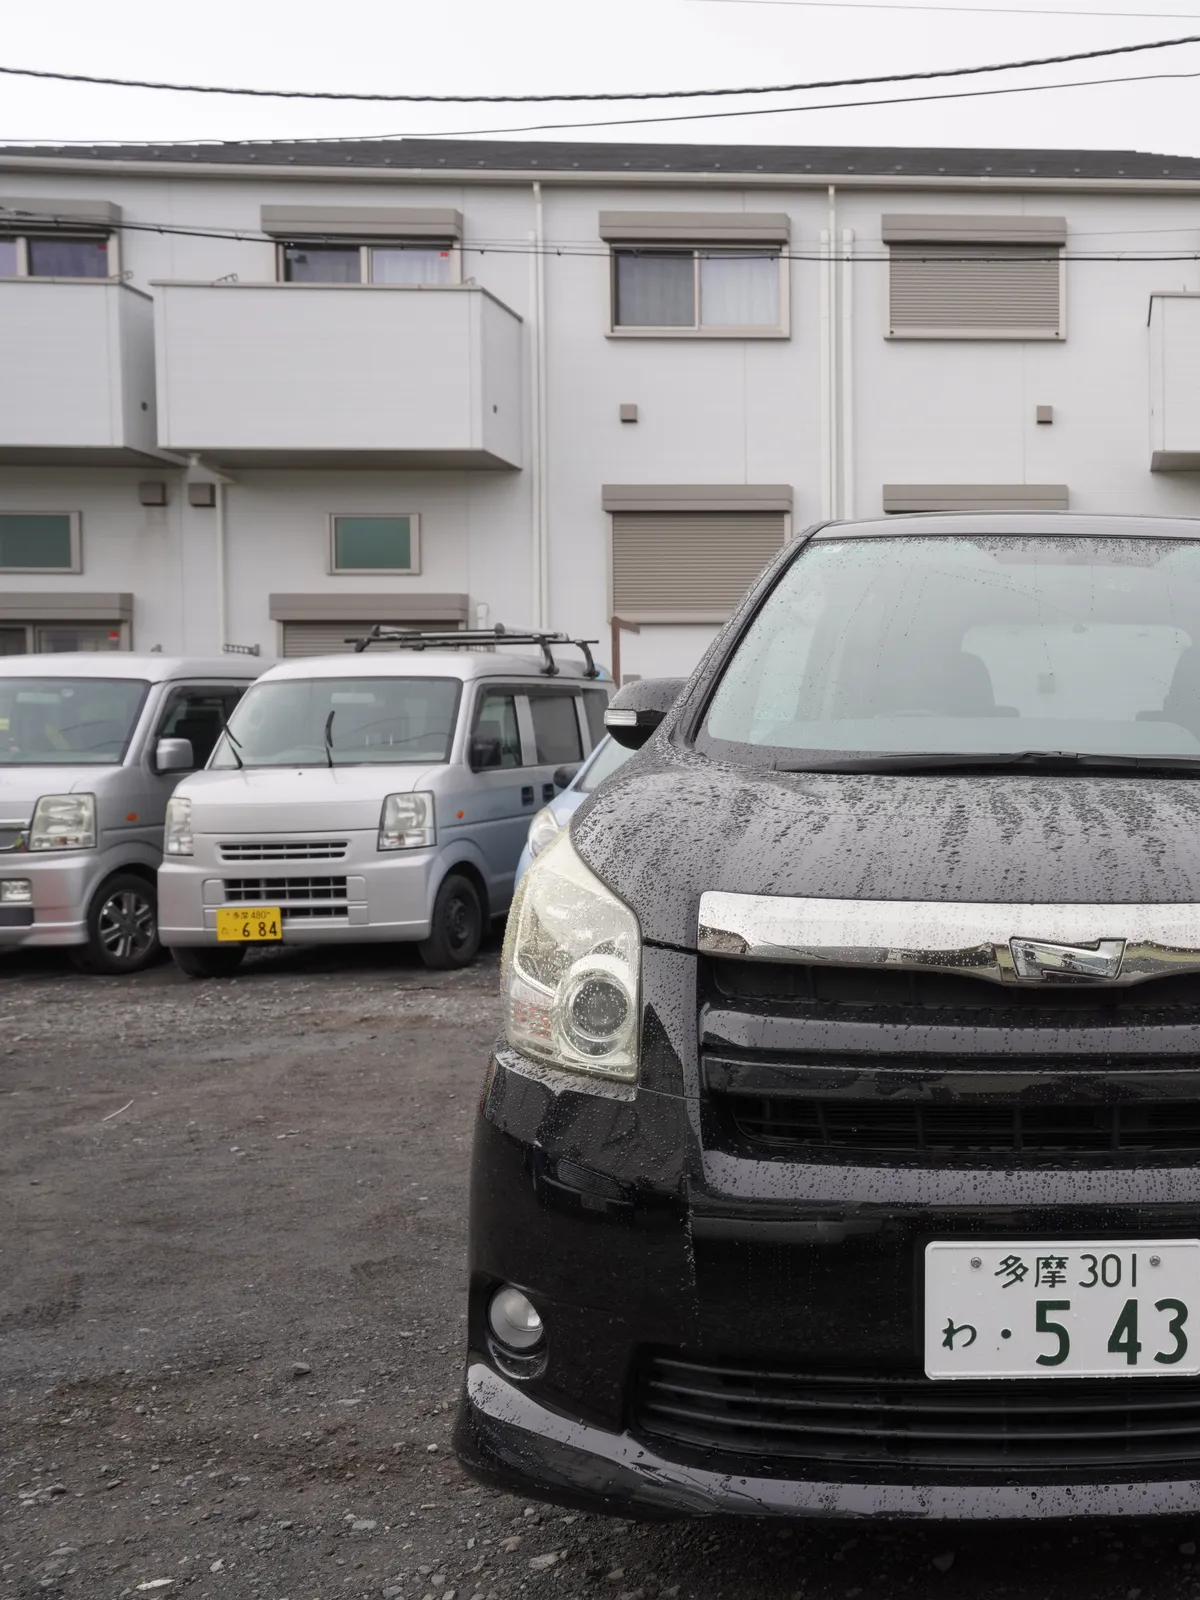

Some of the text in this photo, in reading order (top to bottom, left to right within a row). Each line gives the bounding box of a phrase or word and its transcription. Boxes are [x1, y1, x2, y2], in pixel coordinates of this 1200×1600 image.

[251, 910, 266, 919] 480
[995, 1254, 1137, 1288] 多摩 301
[941, 1317, 977, 1351] わ
